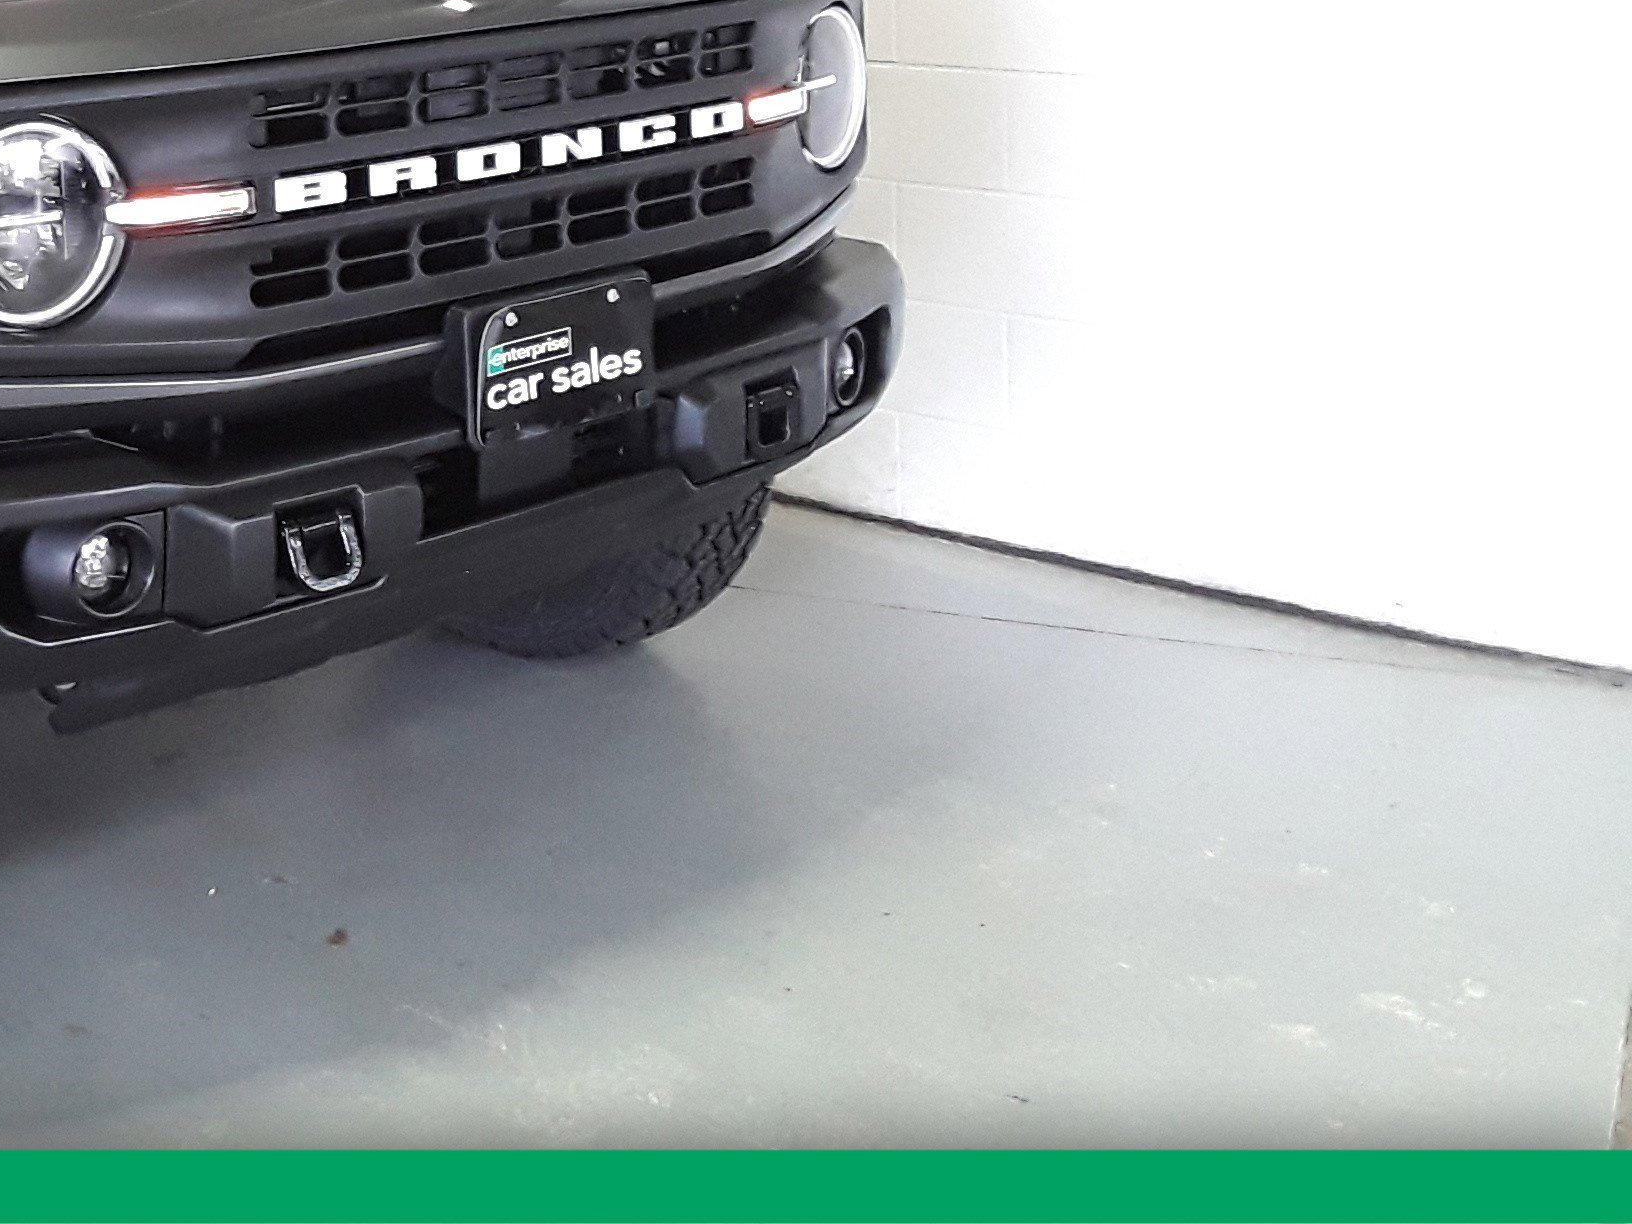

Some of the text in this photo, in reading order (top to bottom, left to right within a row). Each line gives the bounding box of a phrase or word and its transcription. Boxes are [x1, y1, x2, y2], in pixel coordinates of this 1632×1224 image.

[274, 101, 744, 213] BRONCO
[486, 346, 643, 410] car sales
[488, 337, 570, 366] enterprise
